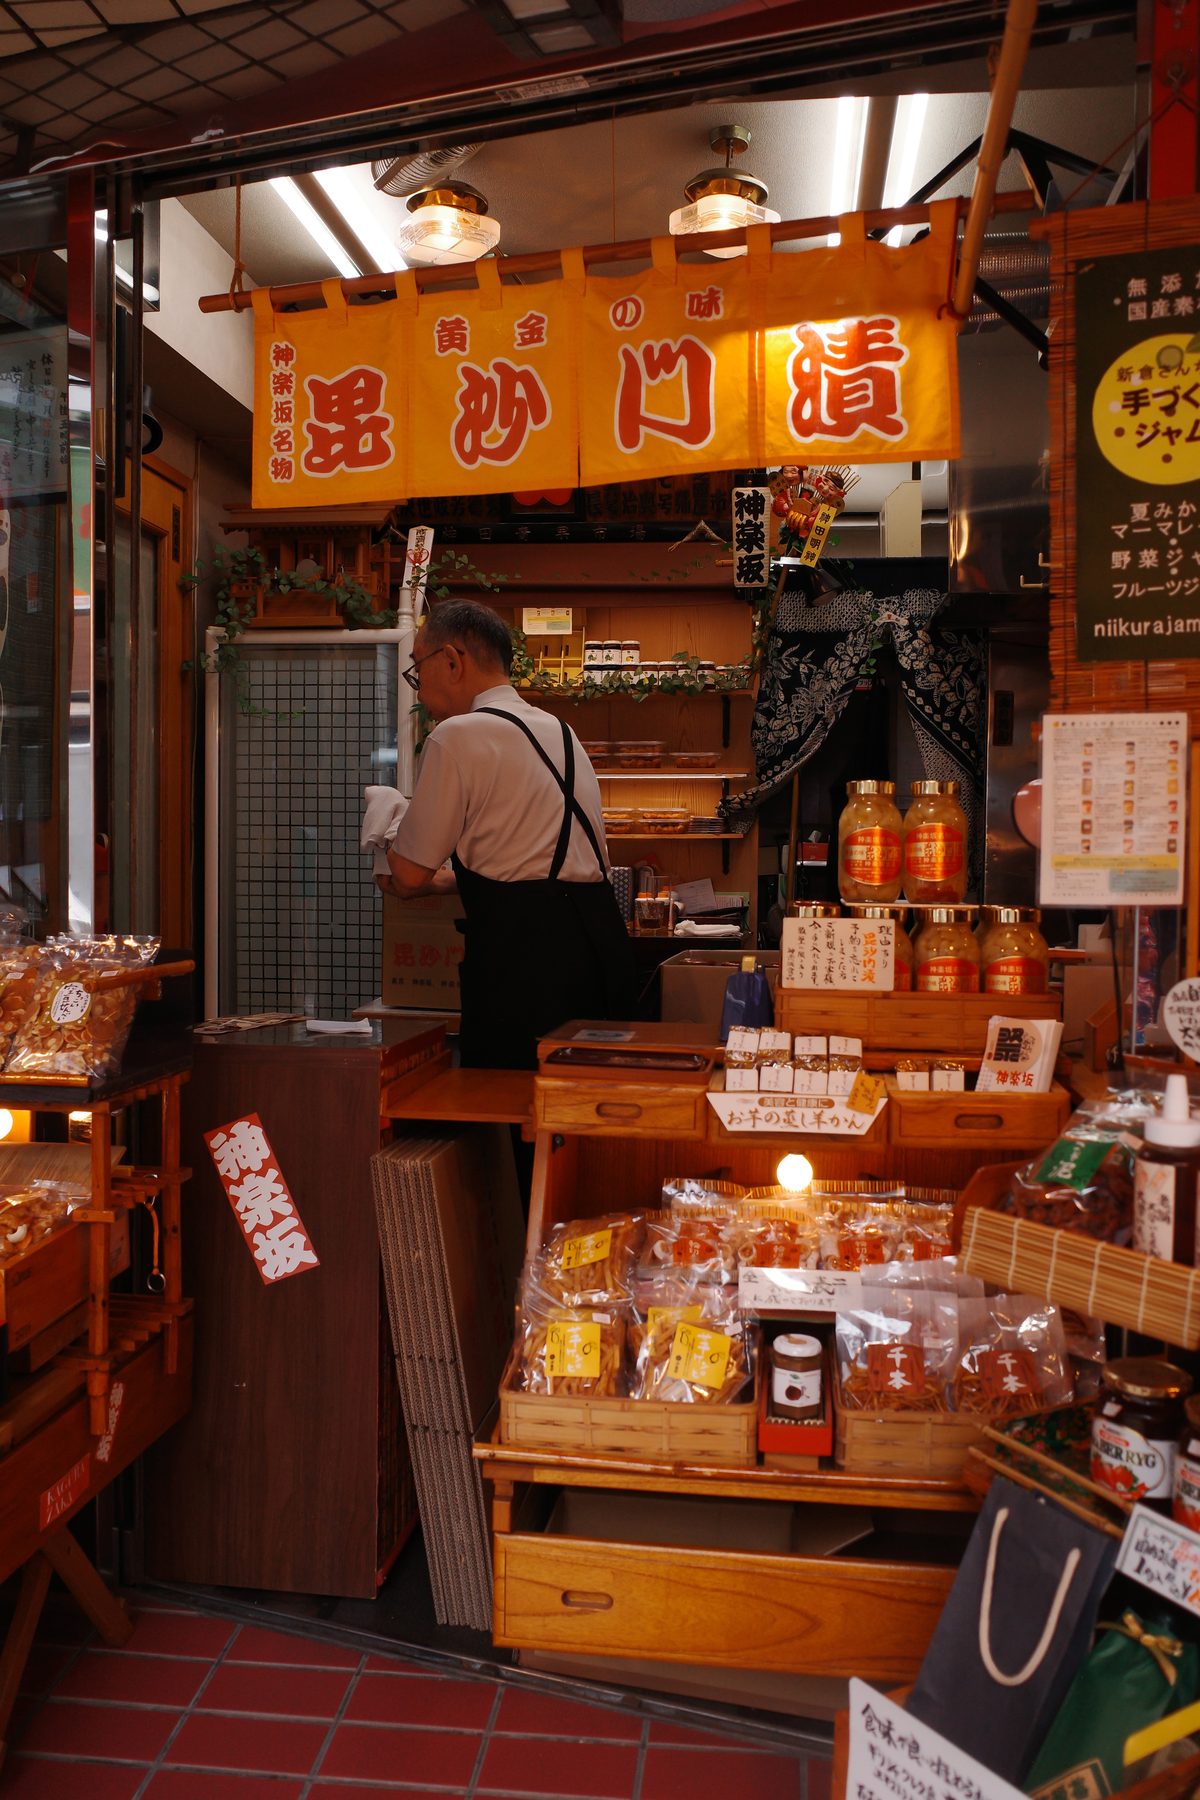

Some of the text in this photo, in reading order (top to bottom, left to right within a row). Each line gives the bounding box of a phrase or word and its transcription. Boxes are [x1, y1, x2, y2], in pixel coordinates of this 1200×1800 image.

[1127, 272, 1200, 298] 無添
[1127, 296, 1200, 322] 国産素
[269, 341, 297, 483] 神楽坂名物
[735, 489, 765, 584] 神楽坂
[803, 511, 832, 563] 神田明神
[1110, 519, 1200, 539] マーマレ
[209, 1120, 318, 1280] 神楽坂
[887, 1346, 913, 1391] 千本
[997, 1352, 1027, 1394] 千本
